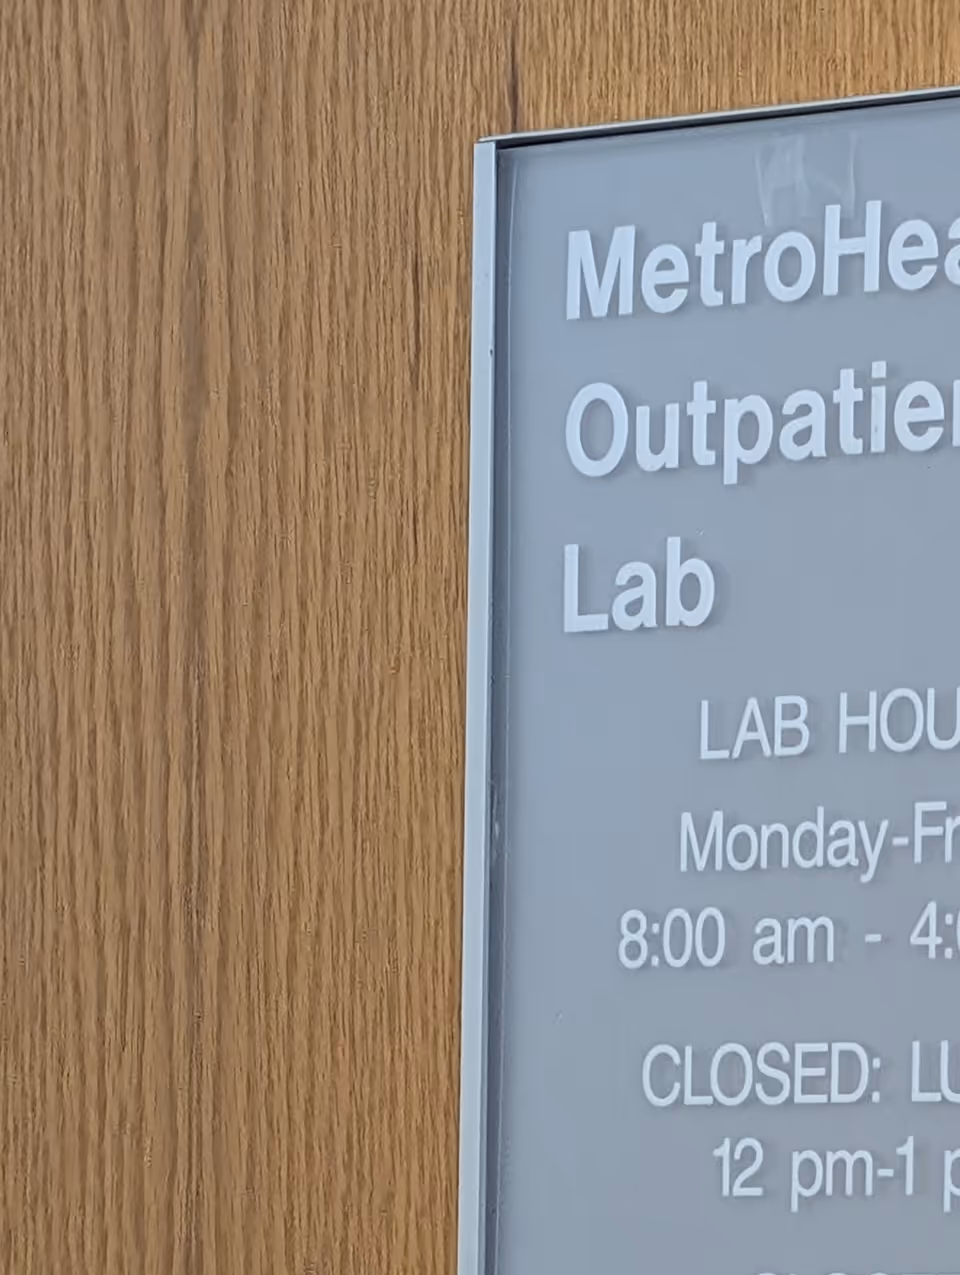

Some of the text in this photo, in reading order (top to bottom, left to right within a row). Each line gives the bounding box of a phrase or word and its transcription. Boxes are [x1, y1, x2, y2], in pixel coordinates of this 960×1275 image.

[564, 537, 714, 632] Lab
[701, 696, 809, 759] LAB
[619, 907, 725, 968] 8:00
[753, 916, 833, 964] am
[643, 1042, 880, 1106] CLOSED:
[713, 1138, 763, 1196] 12
[791, 1136, 913, 1212] pm-1
